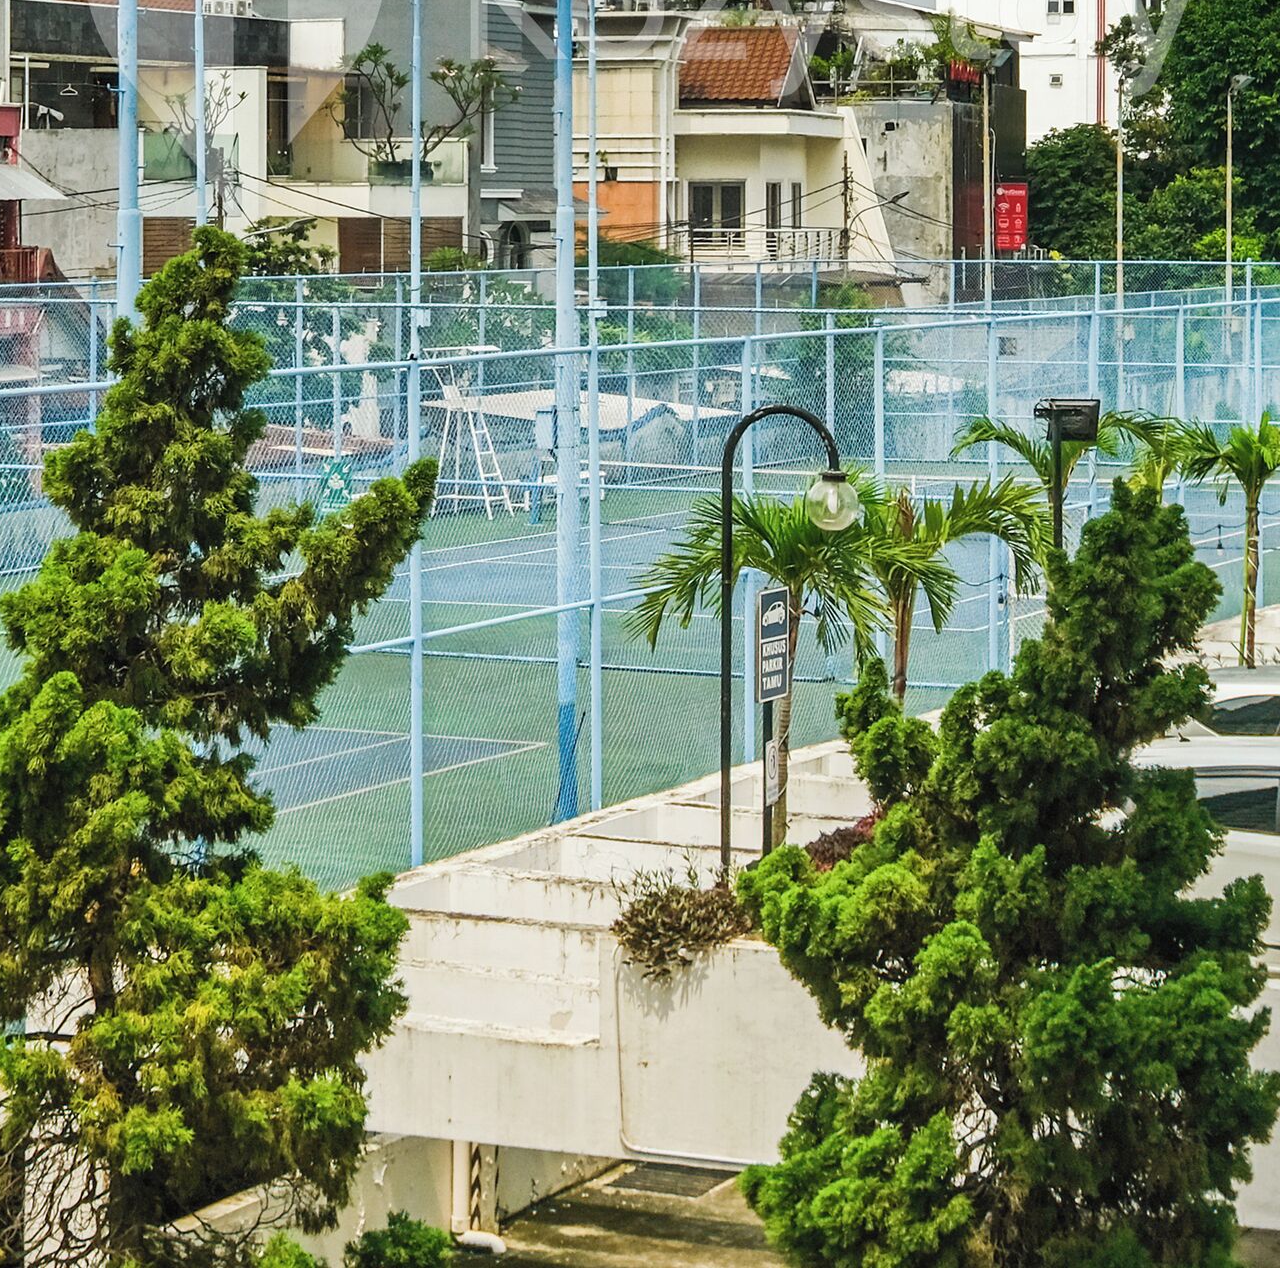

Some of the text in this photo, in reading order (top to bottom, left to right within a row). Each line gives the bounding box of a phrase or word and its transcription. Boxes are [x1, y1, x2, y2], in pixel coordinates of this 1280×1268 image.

[762, 639, 786, 658] KHUSUS
[762, 656, 783, 674] PARKIR
[762, 674, 783, 691] TAMU
